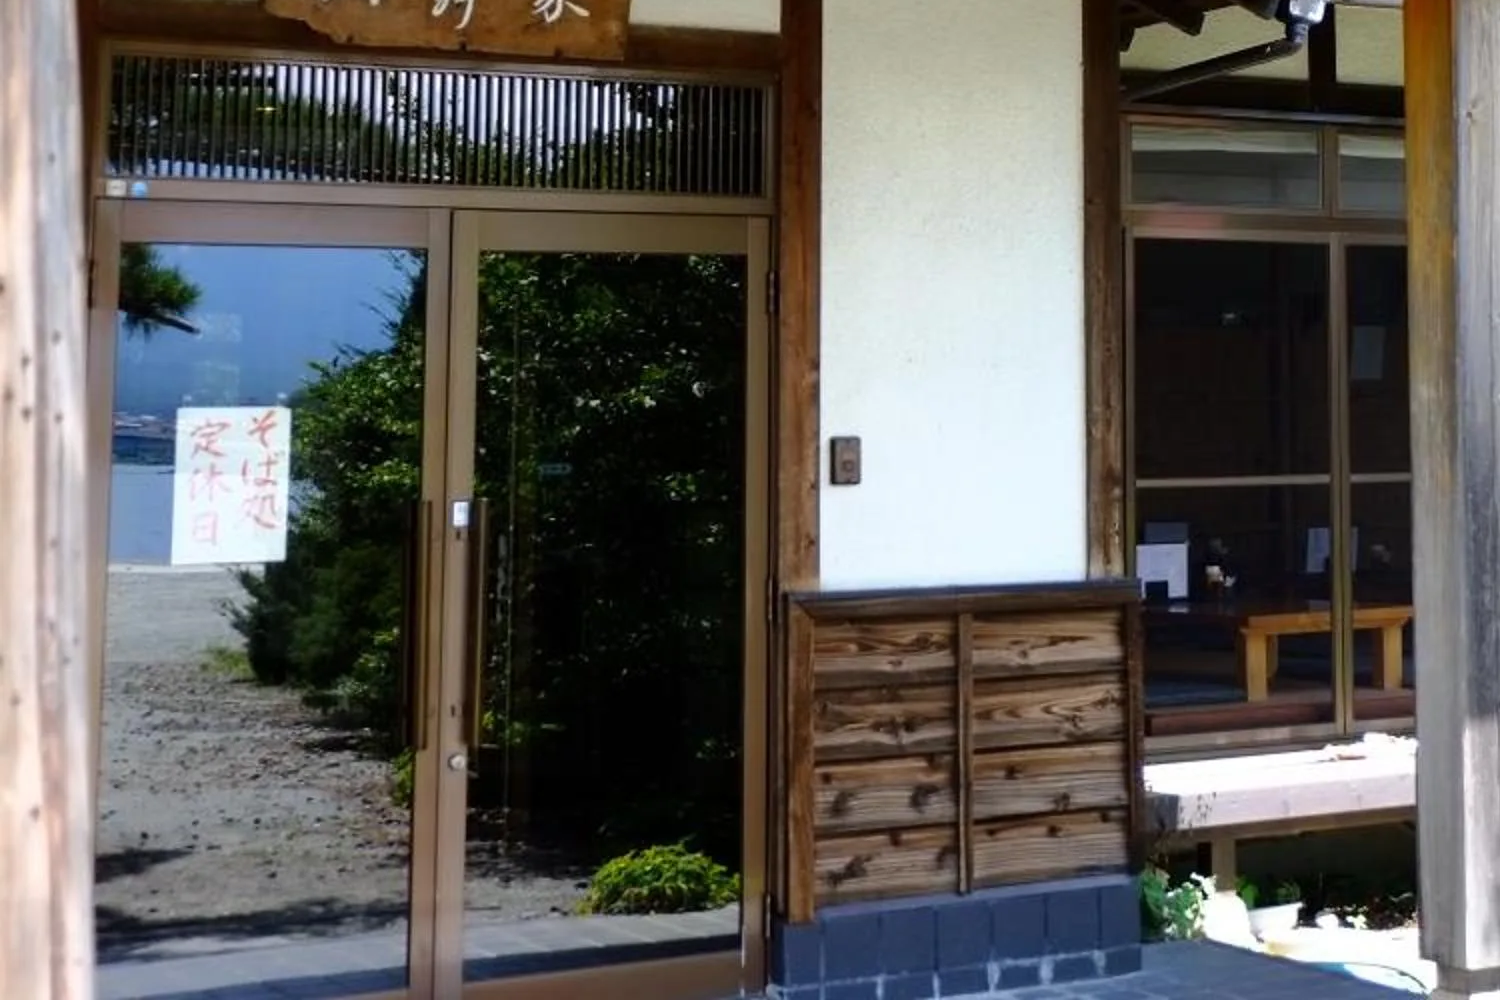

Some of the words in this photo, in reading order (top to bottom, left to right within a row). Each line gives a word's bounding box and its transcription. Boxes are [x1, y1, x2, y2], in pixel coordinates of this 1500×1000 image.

[189, 420, 231, 546] 定休日
[240, 410, 283, 529] そば処
